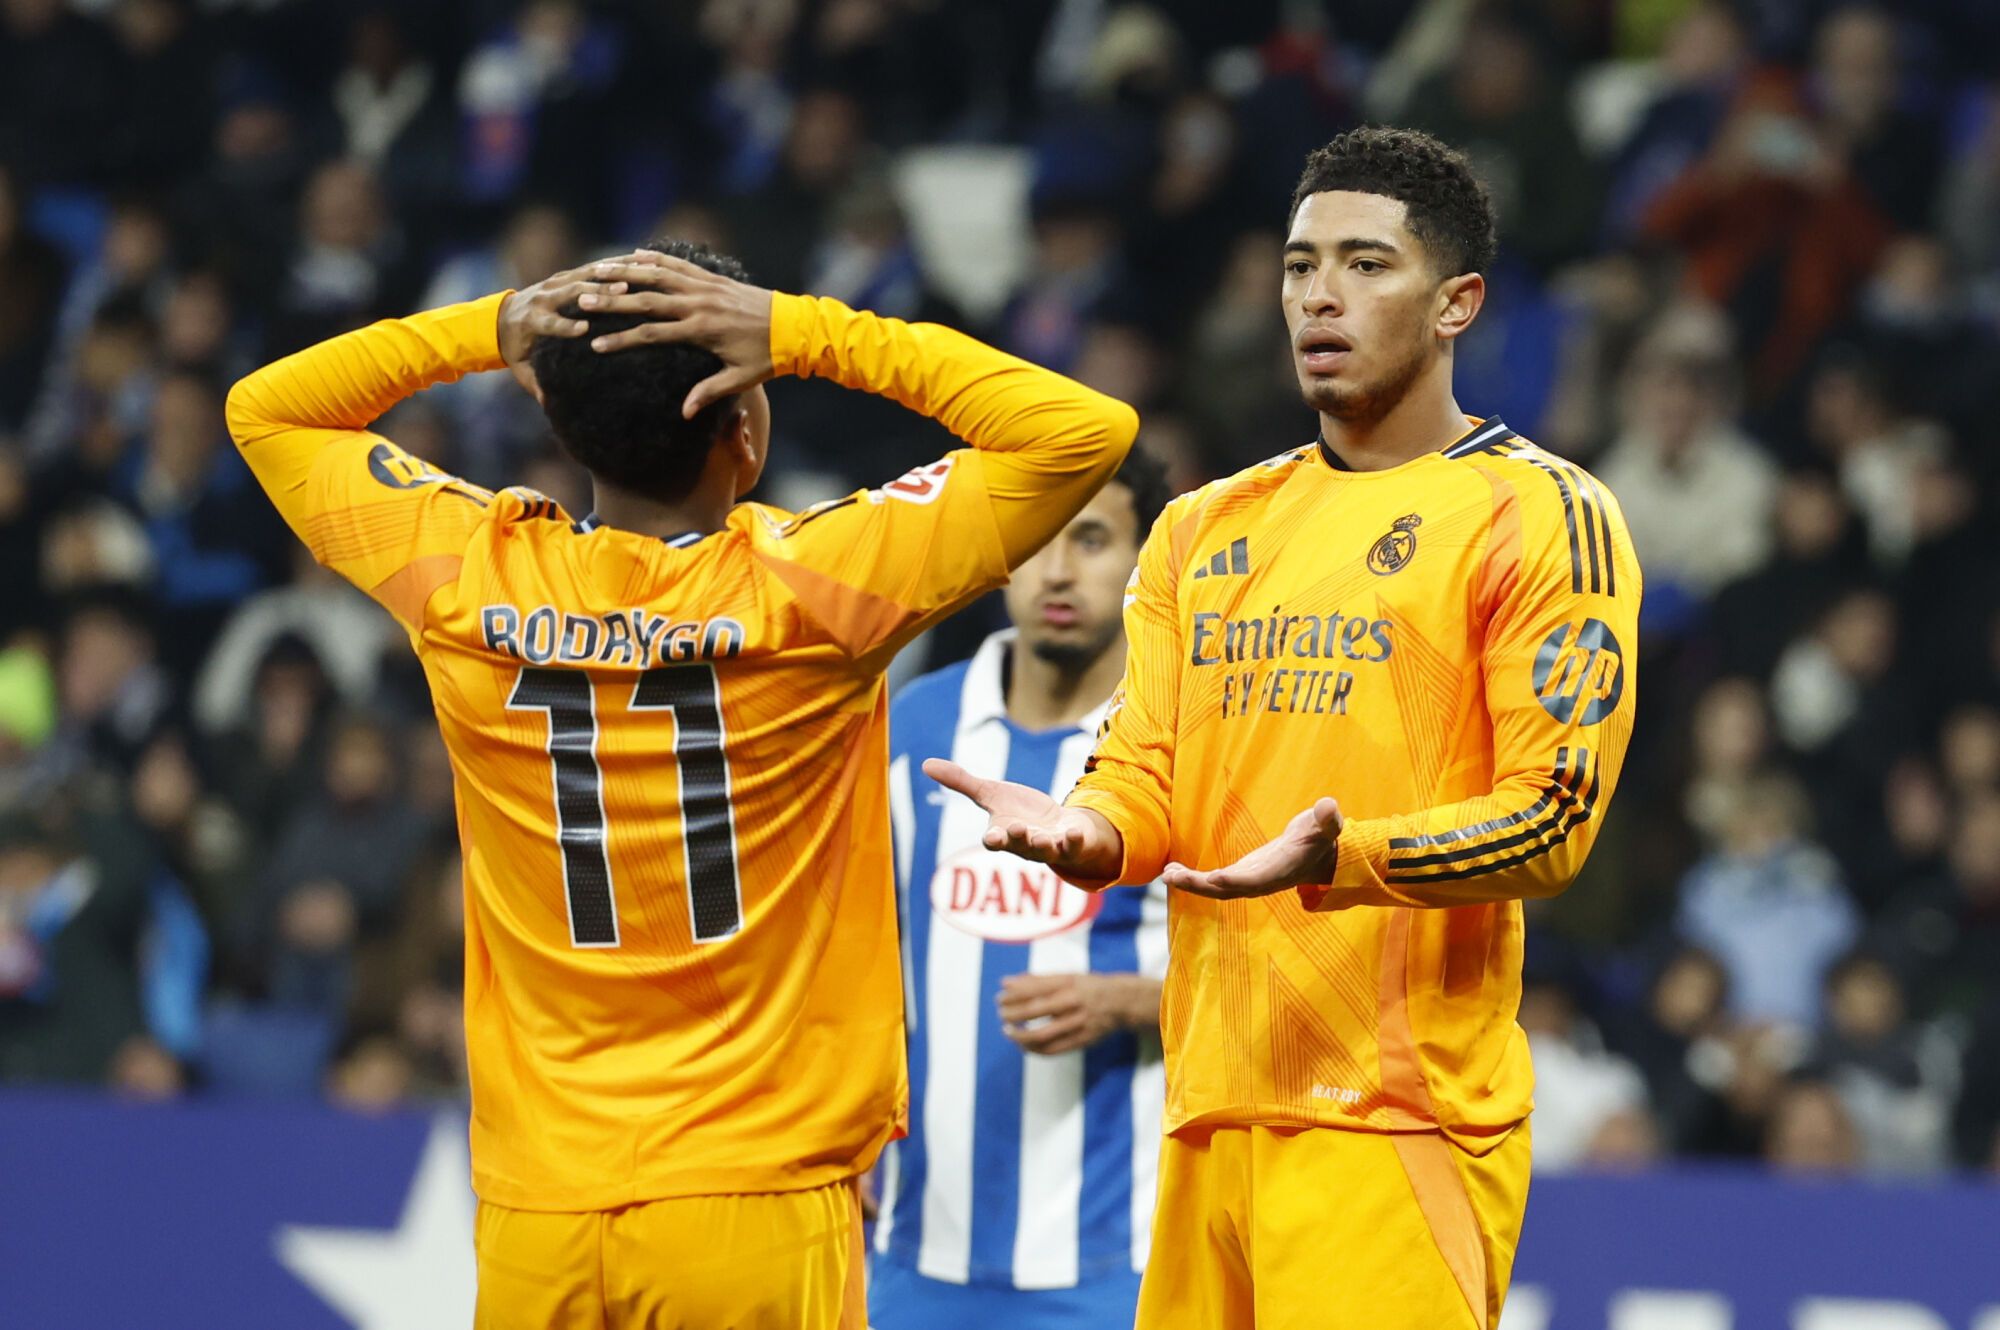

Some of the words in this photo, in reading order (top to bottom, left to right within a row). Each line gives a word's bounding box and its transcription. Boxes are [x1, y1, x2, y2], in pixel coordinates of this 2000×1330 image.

[481, 604, 745, 670] RODRYGO
[1191, 605, 1393, 666] Emirates
[1222, 672, 1255, 719] FY
[1532, 617, 1624, 727] hp
[505, 663, 743, 947] 11
[951, 865, 1065, 917] DANI
